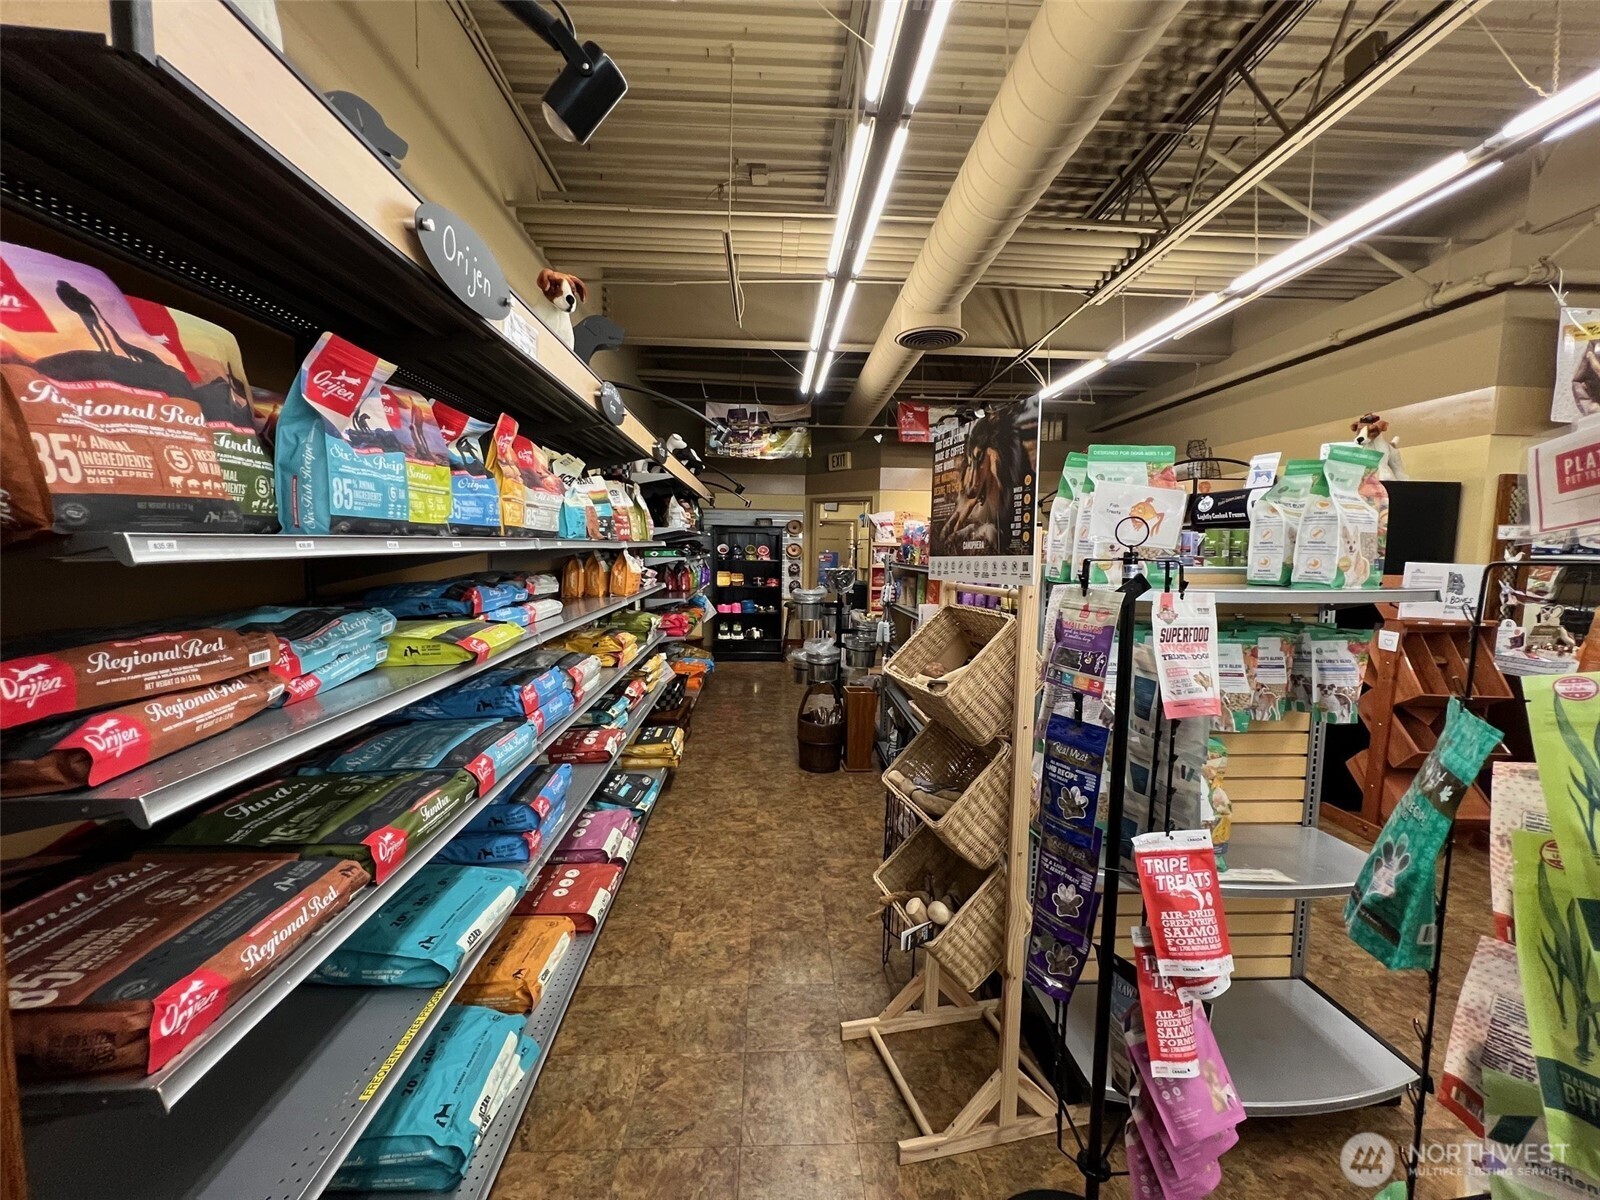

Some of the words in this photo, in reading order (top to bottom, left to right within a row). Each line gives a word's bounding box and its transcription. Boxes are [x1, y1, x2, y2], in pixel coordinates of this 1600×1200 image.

[443, 225, 491, 298] Orijen
[313, 370, 355, 401] Orijen
[20, 380, 157, 420] Regional
[160, 404, 206, 428] Red
[89, 435, 135, 453] ANIMAL
[77, 450, 153, 469] INGREDIENTS
[831, 454, 846, 469] EXIT
[83, 468, 154, 479] WHOLEPREY
[86, 476, 115, 484] DIET
[1564, 473, 1581, 486] PET
[1449, 595, 1474, 605] BONES
[1159, 626, 1210, 643] SUPERFOOD
[86, 644, 182, 674] Regional
[181, 637, 226, 660] Red
[1159, 642, 1208, 654] NUGGETS
[144, 687, 219, 722] Regional
[214, 679, 248, 697] Red
[1052, 741, 1069, 756] Real
[1069, 748, 1089, 762] Meat
[1057, 766, 1079, 782] RECIPE
[420, 795, 450, 822] Tundra
[1143, 856, 1189, 874] TRIPE
[1155, 871, 1211, 891] TREATS
[240, 905, 311, 971] Regional
[307, 884, 339, 918] Red
[1161, 919, 1194, 928] GREEN
[160, 989, 219, 1036] Orijen
[1156, 1018, 1183, 1028] GREEN
[362, 1044, 404, 1097] FREQUENT
[399, 1019, 421, 1046] BUYER
